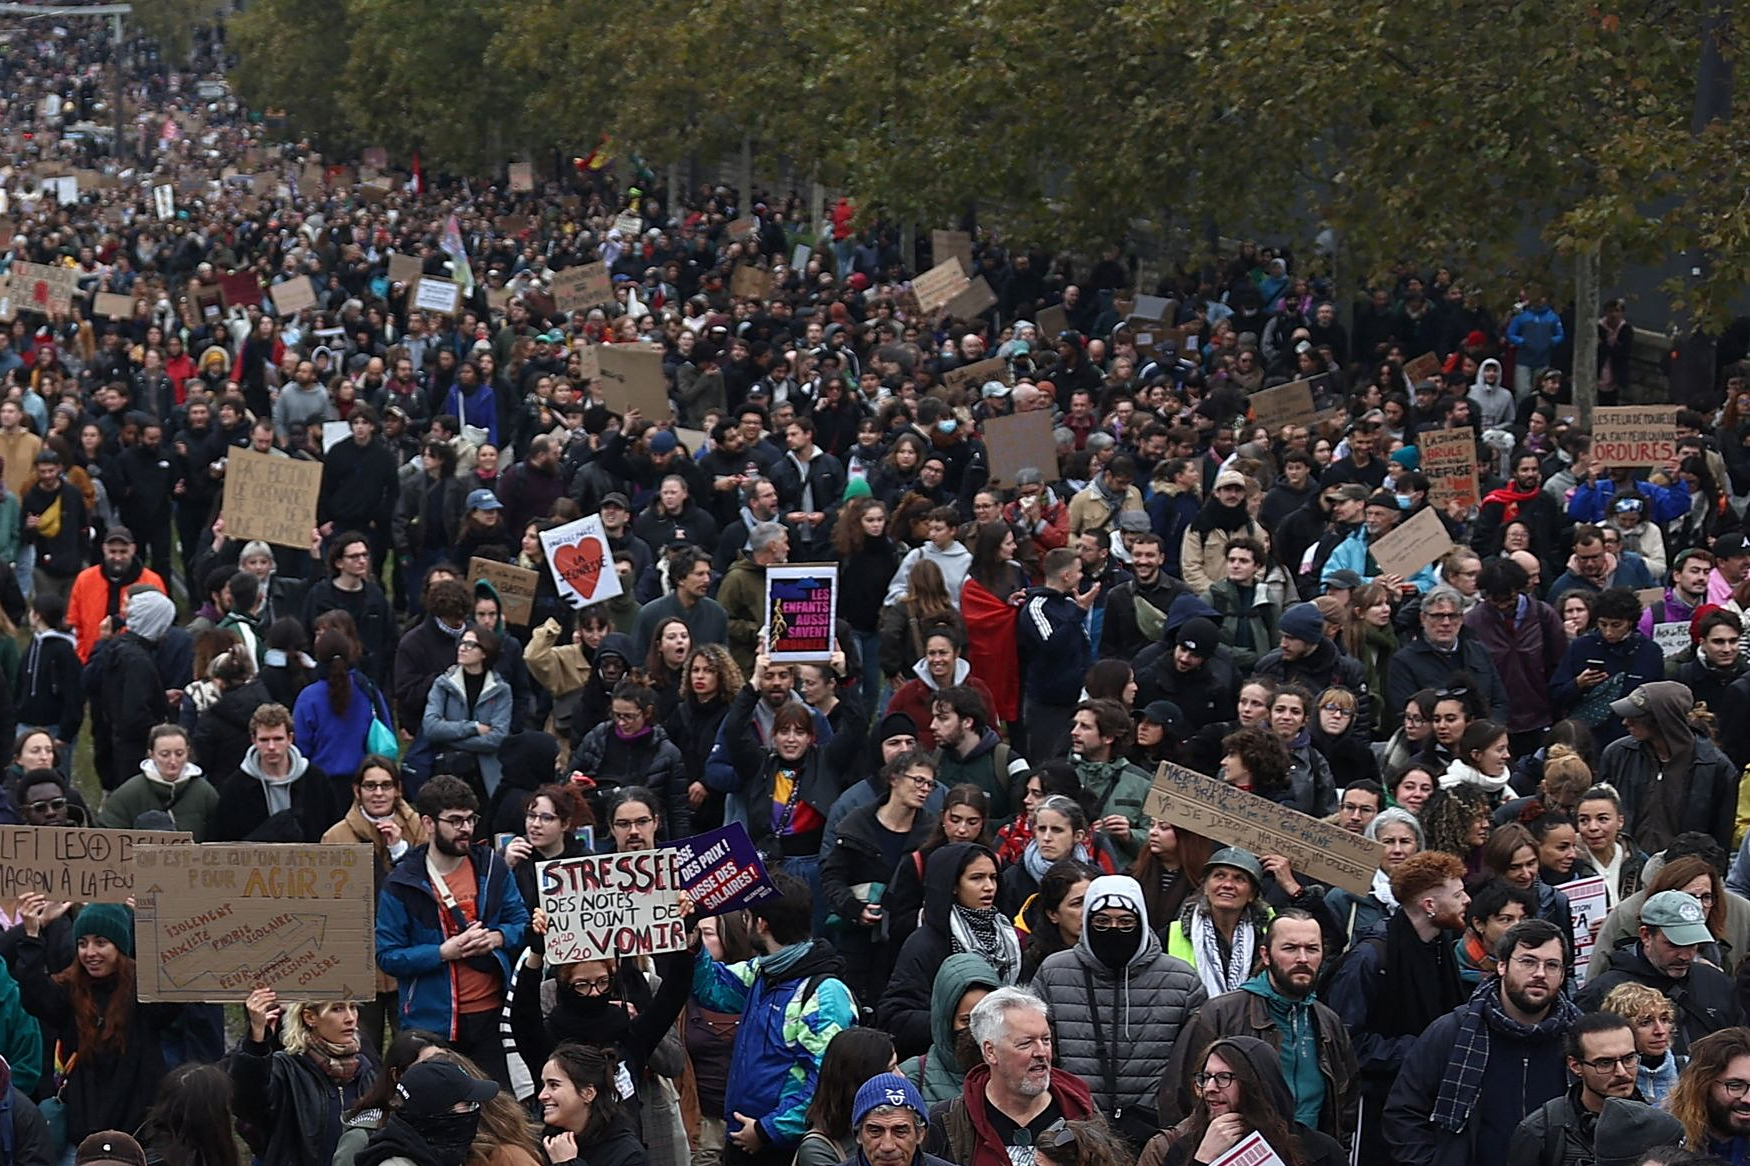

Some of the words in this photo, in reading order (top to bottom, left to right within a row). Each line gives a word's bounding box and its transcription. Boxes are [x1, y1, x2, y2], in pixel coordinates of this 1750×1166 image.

[1594, 442, 1673, 461] ORDURES
[811, 588, 829, 600] LES
[783, 601, 829, 613] ENFANTS
[795, 614, 828, 625] AUSSI
[788, 627, 828, 637] SAVENT
[1163, 764, 1201, 788] MACRON
[1, 828, 38, 860] LFi
[677, 844, 695, 866] SSE
[285, 849, 358, 867] ATTEND
[681, 860, 701, 882] DES
[698, 843, 725, 869] PRIX
[722, 839, 730, 852] !
[62, 862, 71, 897] À
[81, 871, 97, 898] LA
[100, 870, 134, 892] POU
[188, 869, 236, 889] POUR
[241, 867, 320, 899] AGIR
[329, 869, 349, 900] ?
[715, 862, 737, 883] DES
[704, 871, 752, 910] SALAIRES
[749, 866, 758, 878] !
[545, 896, 576, 913] DES
[581, 892, 634, 911] NOTES
[547, 915, 569, 933] AU
[580, 908, 640, 930] POINT
[653, 904, 680, 921] DE
[211, 924, 252, 951] PHOBIE
[244, 912, 295, 944] SCOLAIRE
[587, 921, 685, 955] VOMIR
[555, 942, 592, 961] 4/20
[219, 970, 251, 990] PEUR
[298, 954, 341, 987] COLÈRE
